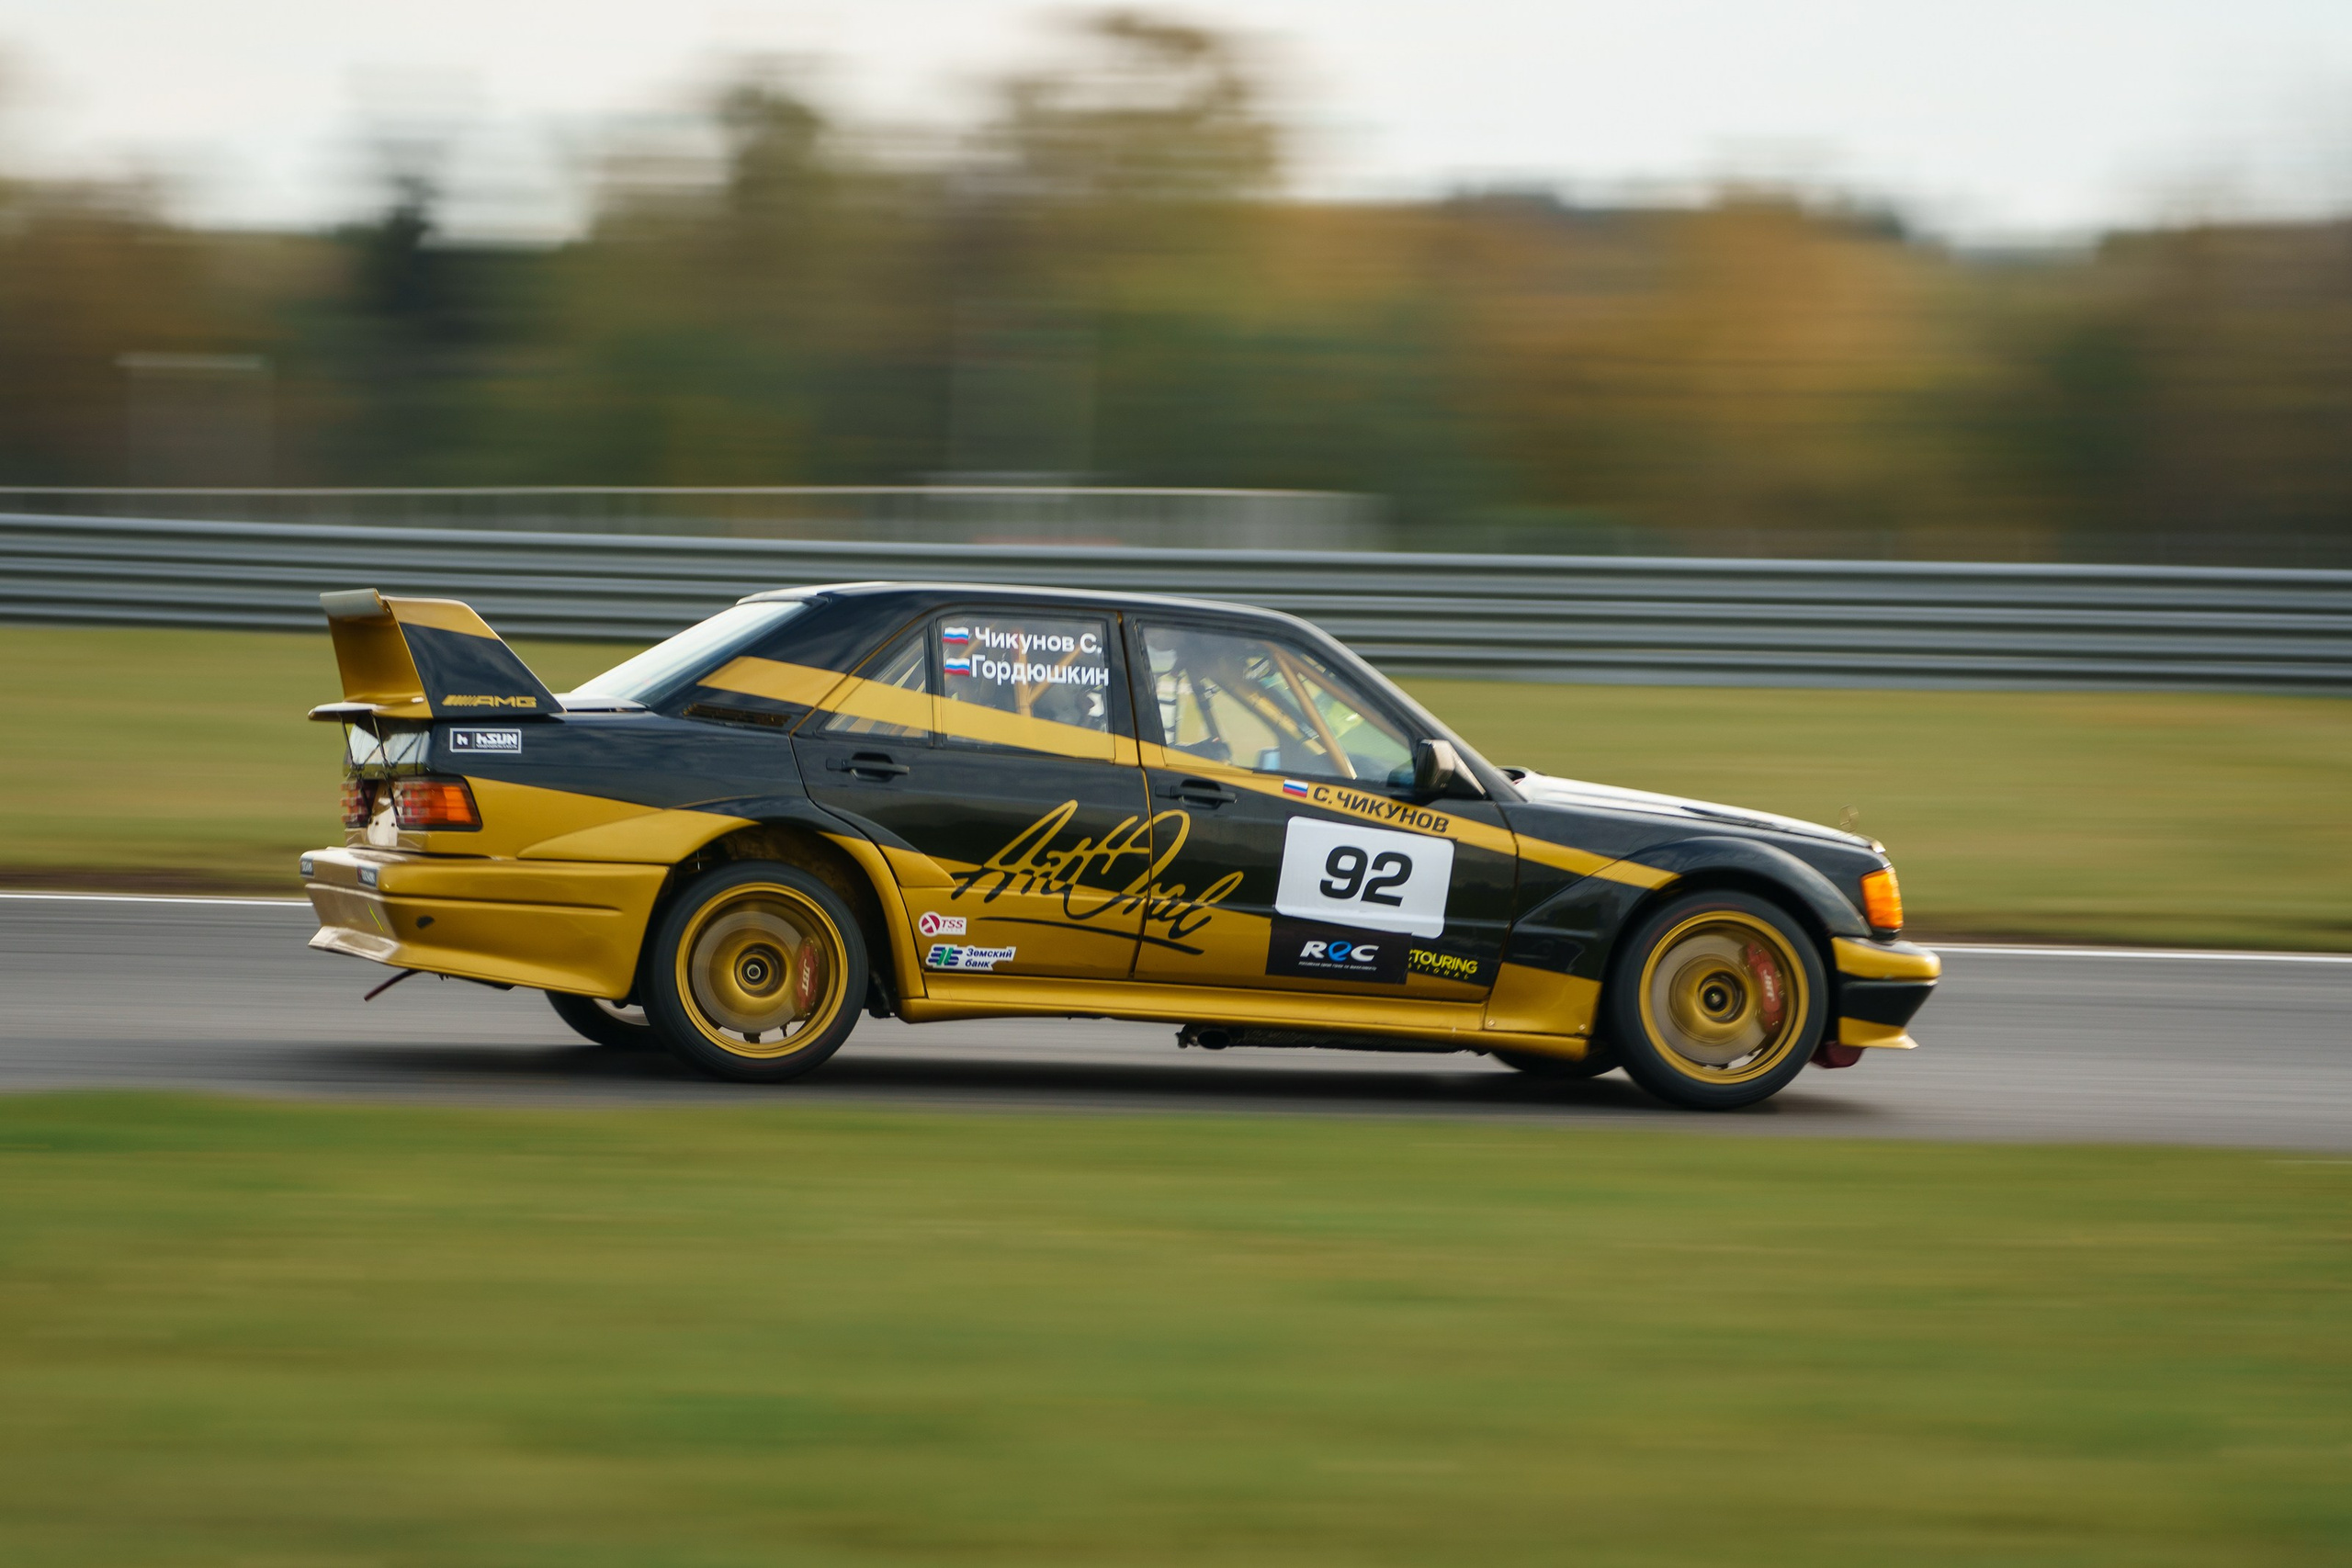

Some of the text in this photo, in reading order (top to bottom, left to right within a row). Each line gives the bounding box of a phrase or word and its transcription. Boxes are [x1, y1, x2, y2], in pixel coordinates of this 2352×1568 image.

[975, 626, 1102, 655] Чикунов С.
[971, 654, 1109, 686] Гордюшкин
[475, 695, 537, 708] AMG
[1319, 845, 1413, 908] 92
[941, 919, 965, 930] TSS
[966, 947, 1013, 959] Земский
[965, 958, 990, 968] банк
